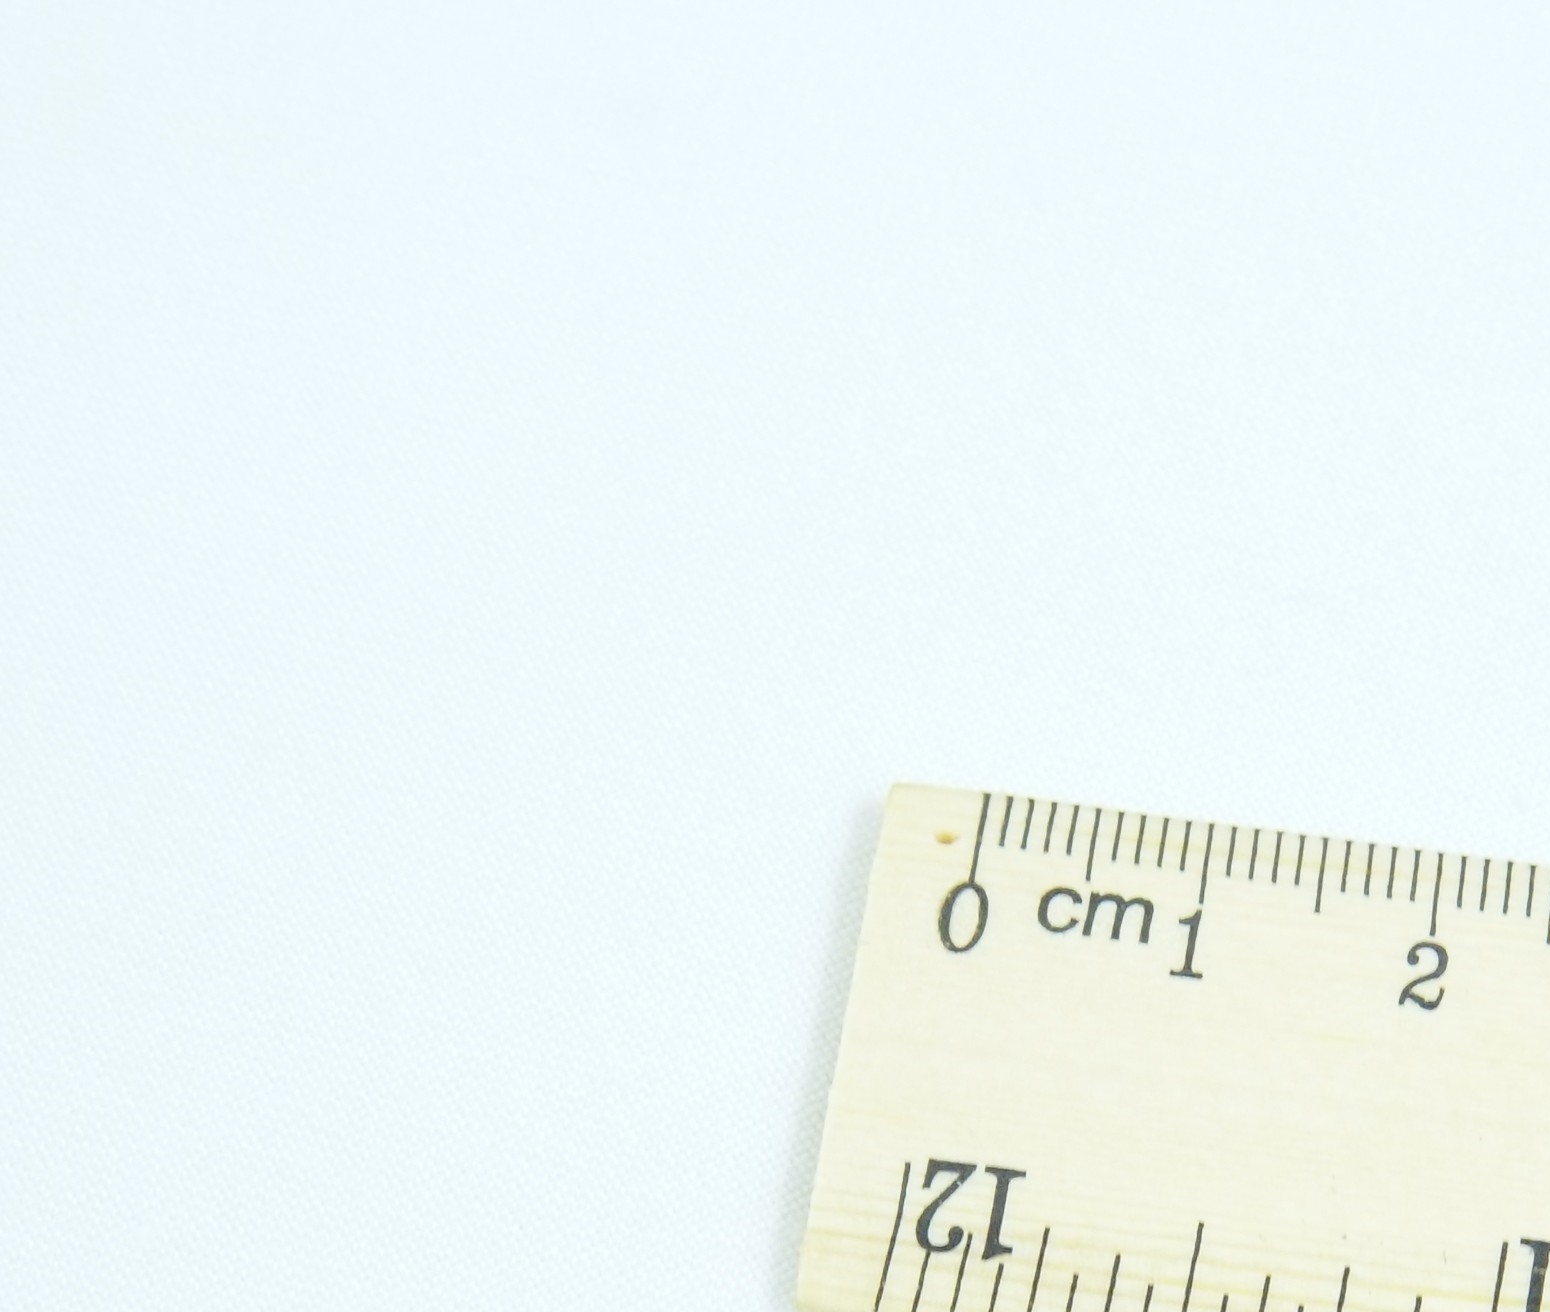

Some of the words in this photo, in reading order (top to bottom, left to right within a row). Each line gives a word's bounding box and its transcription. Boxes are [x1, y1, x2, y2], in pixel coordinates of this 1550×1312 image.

[937, 881, 989, 954] 0
[1037, 888, 1156, 945] cm
[1169, 909, 1205, 979] 1
[1399, 941, 1446, 1010] 2
[914, 1159, 1028, 1263] 12
